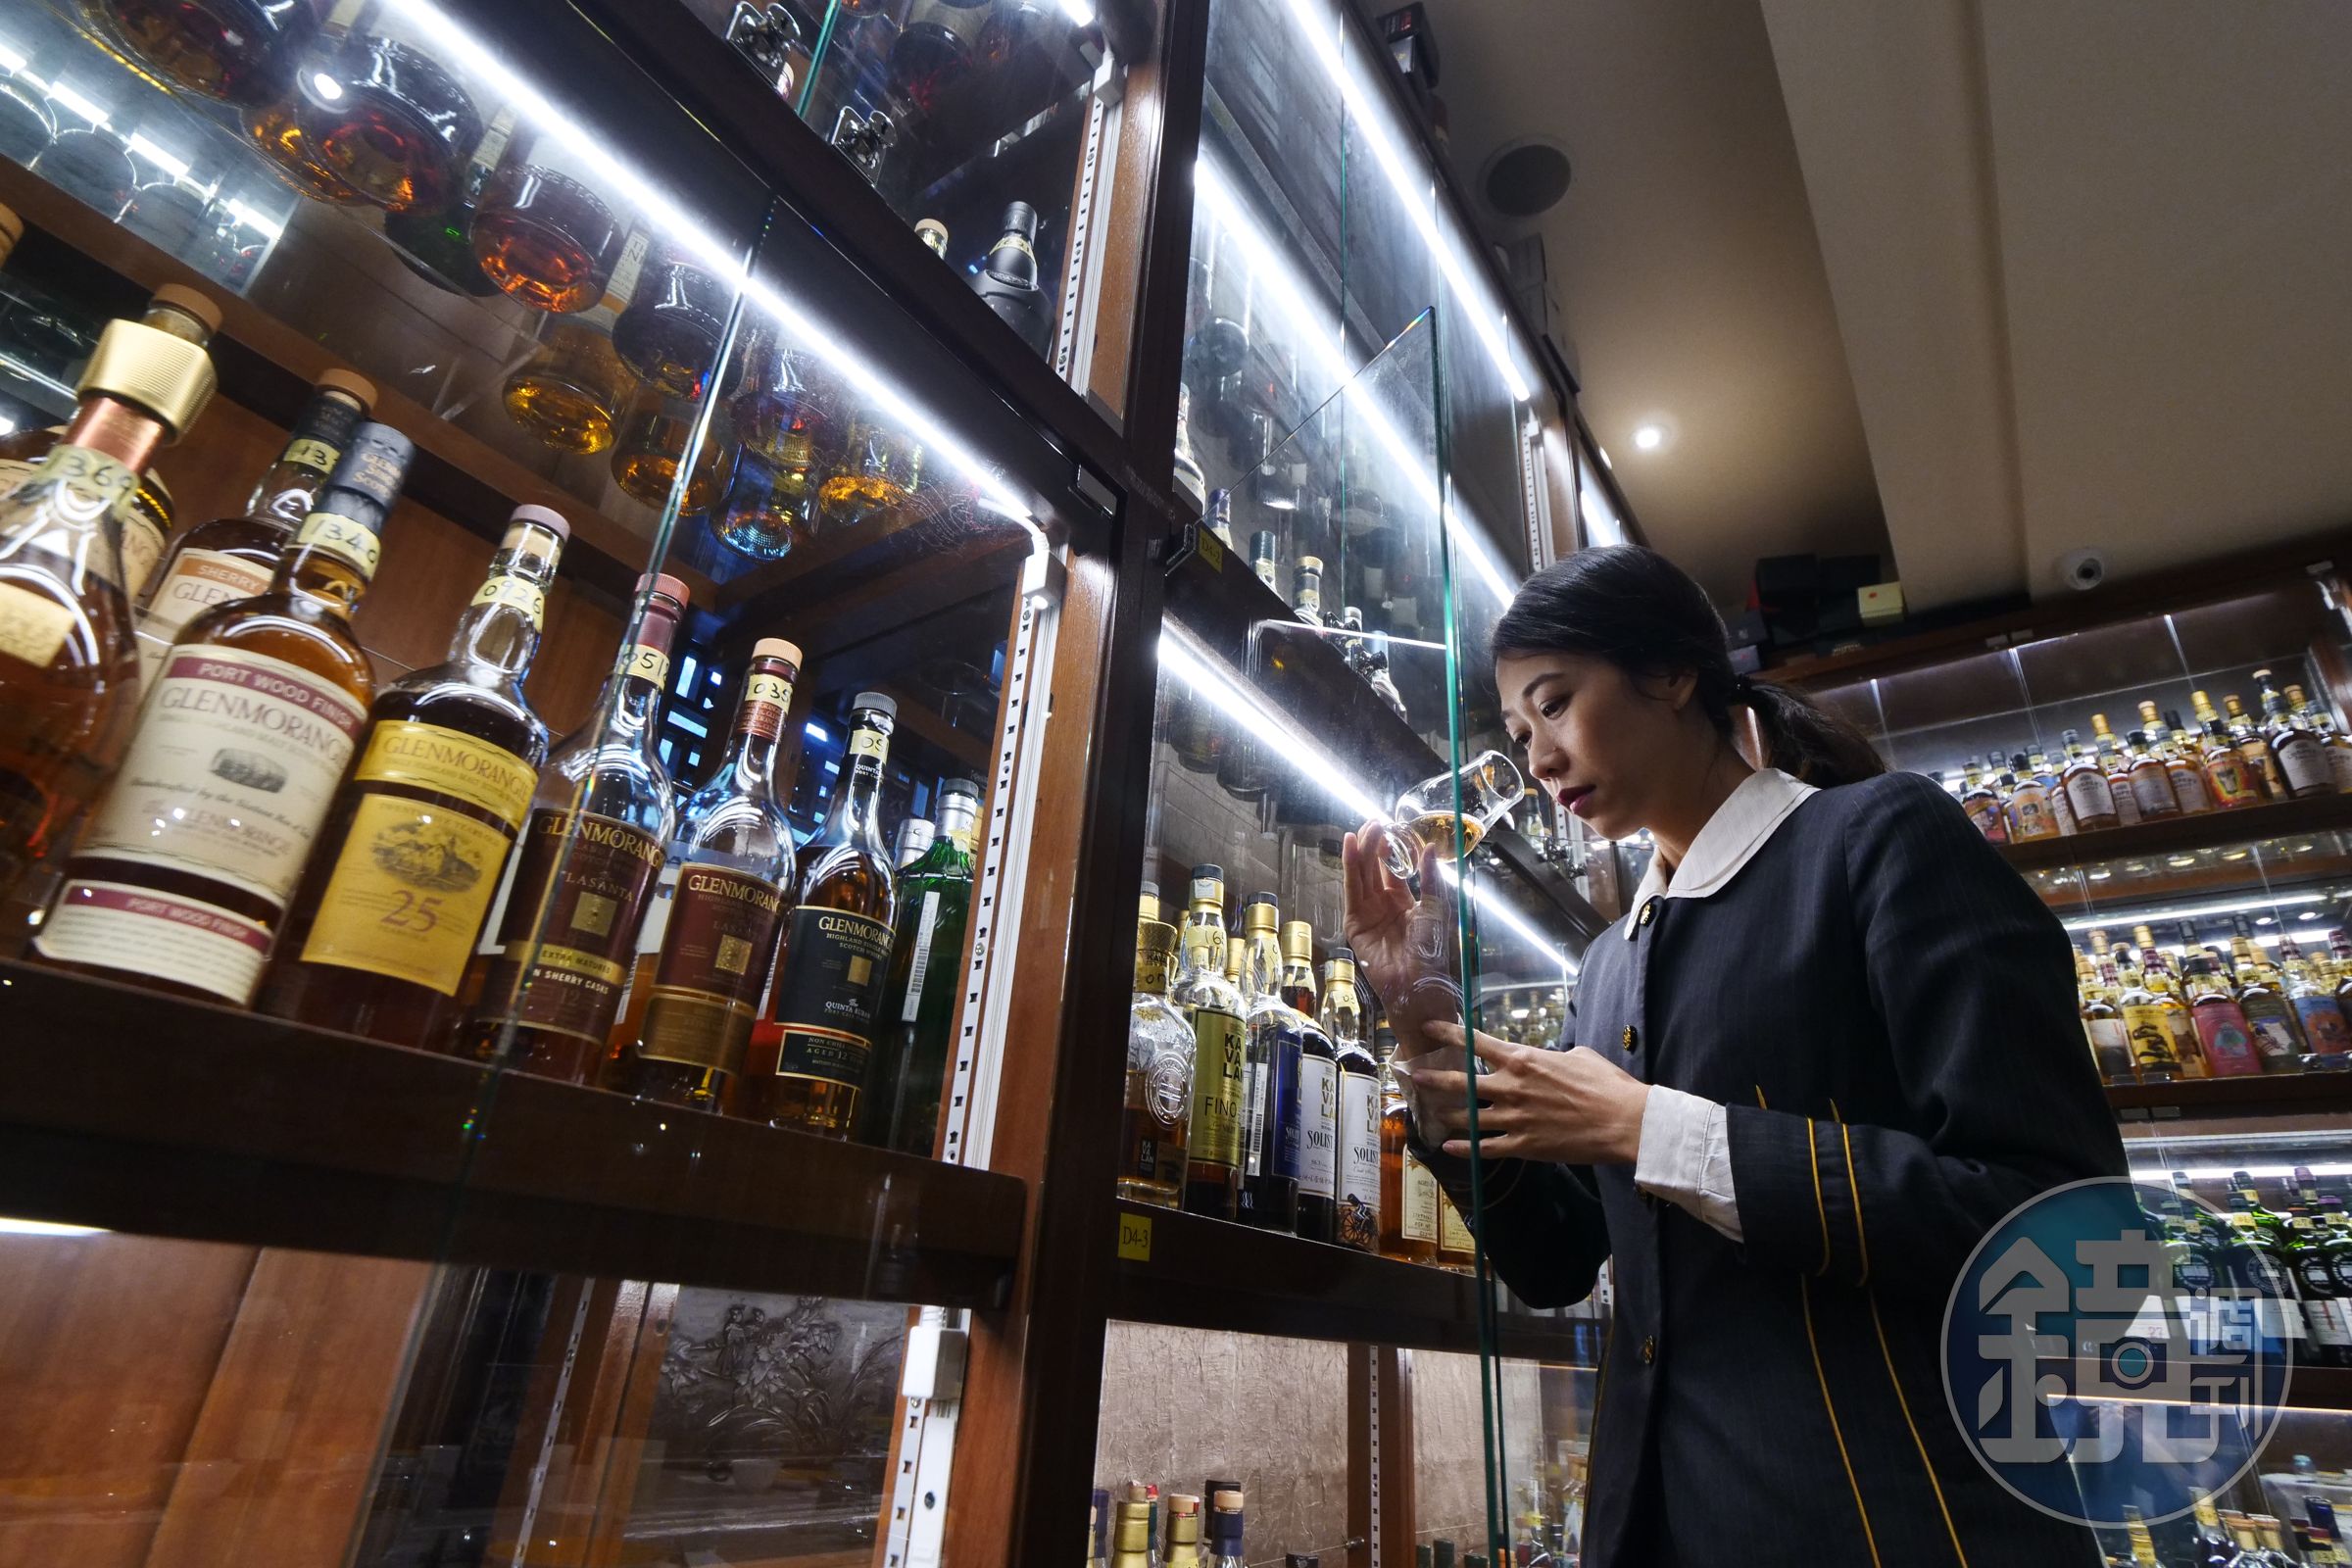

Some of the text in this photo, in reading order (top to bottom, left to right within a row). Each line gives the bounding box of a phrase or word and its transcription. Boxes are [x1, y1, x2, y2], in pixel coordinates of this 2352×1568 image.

[302, 446, 338, 466] 13
[196, 564, 260, 590] SHERRY
[198, 662, 354, 729] PORT WOOD FINISH
[565, 871, 633, 902] LASANTA
[380, 890, 443, 934] 25
[826, 933, 862, 945] HIGHLAND
[839, 942, 864, 953] SCOTCH
[544, 968, 584, 986] SHERRY
[825, 1001, 853, 1013] QUINTA
[1204, 1097, 1238, 1118] FINO
[1306, 1130, 1334, 1151] SOLIST
[1123, 1225, 1149, 1248] D4-3
